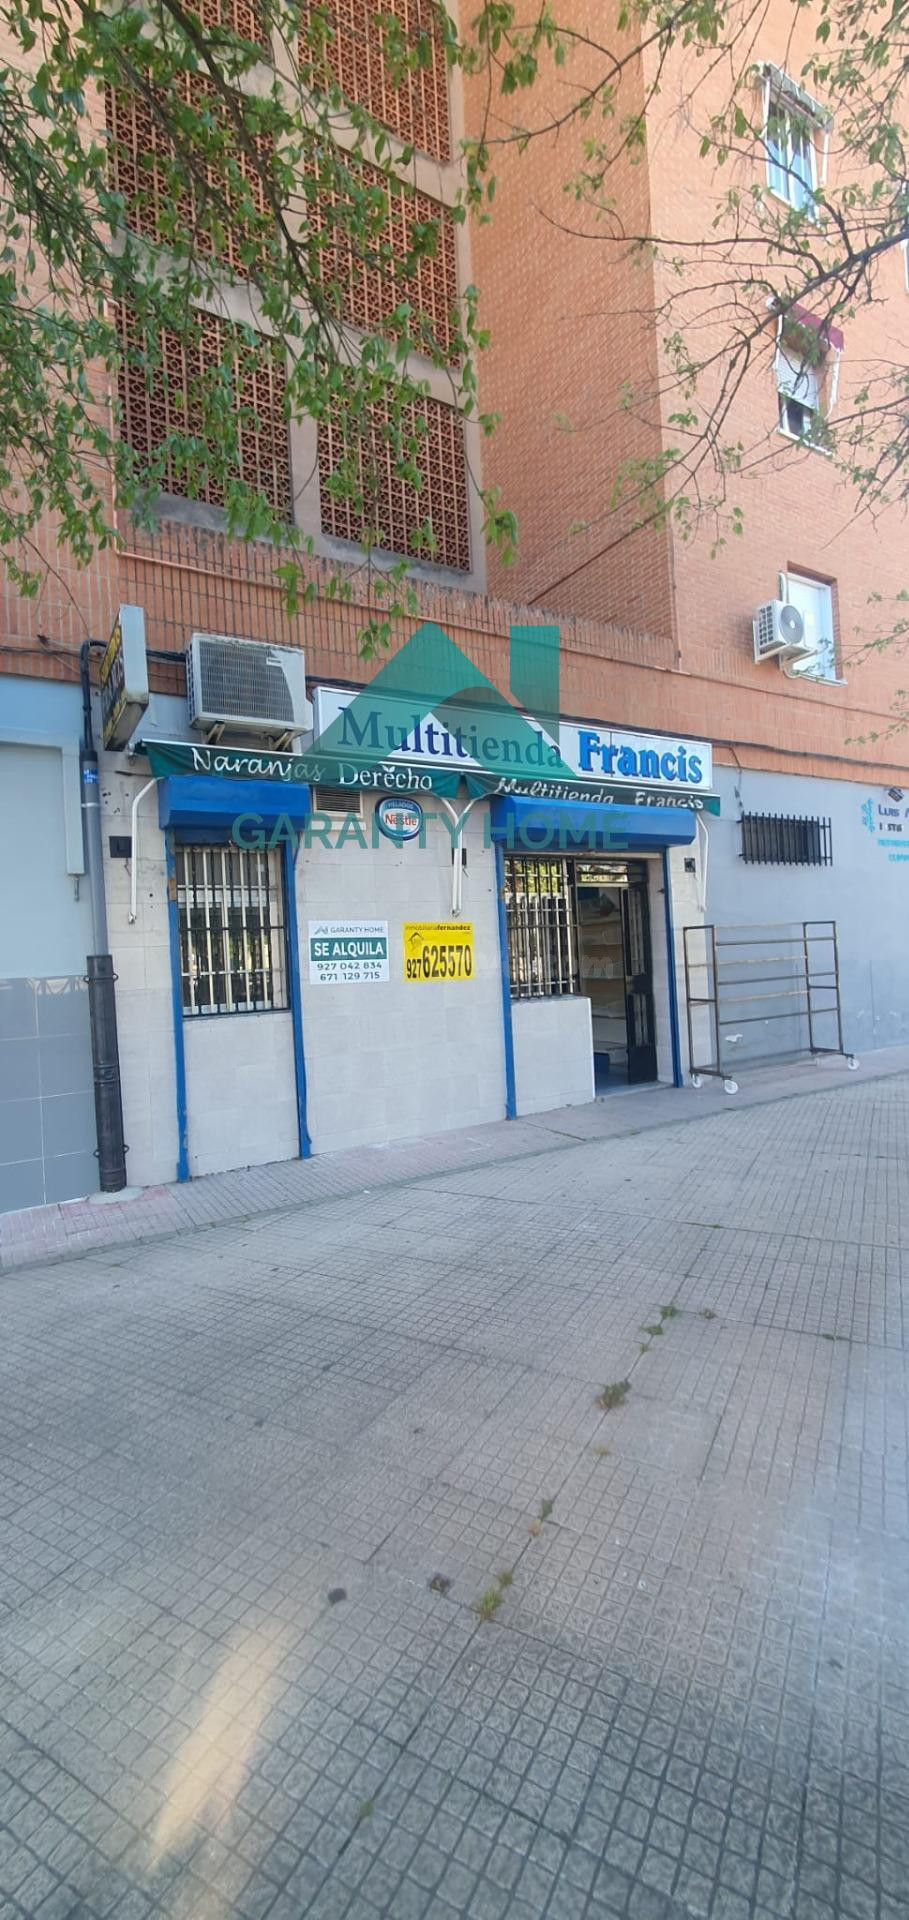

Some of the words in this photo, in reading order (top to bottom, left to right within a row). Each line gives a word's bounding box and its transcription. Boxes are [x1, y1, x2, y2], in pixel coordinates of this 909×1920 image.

[338, 706, 564, 768] Multitienda
[577, 730, 702, 784] Francis
[191, 747, 325, 782] Naranjas
[338, 762, 433, 790] Derecho
[494, 777, 614, 805] Multitienda
[635, 790, 704, 809] Francis
[330, 926, 363, 934] GARANTY
[364, 926, 385, 934] HOME
[314, 942, 330, 957] SE
[332, 941, 385, 958] ALQUILA
[317, 962, 337, 971] 927
[340, 962, 360, 970] 042
[363, 961, 382, 969] 834
[320, 973, 338, 981] 671
[343, 972, 361, 980] 129
[363, 971, 380, 980] 715
